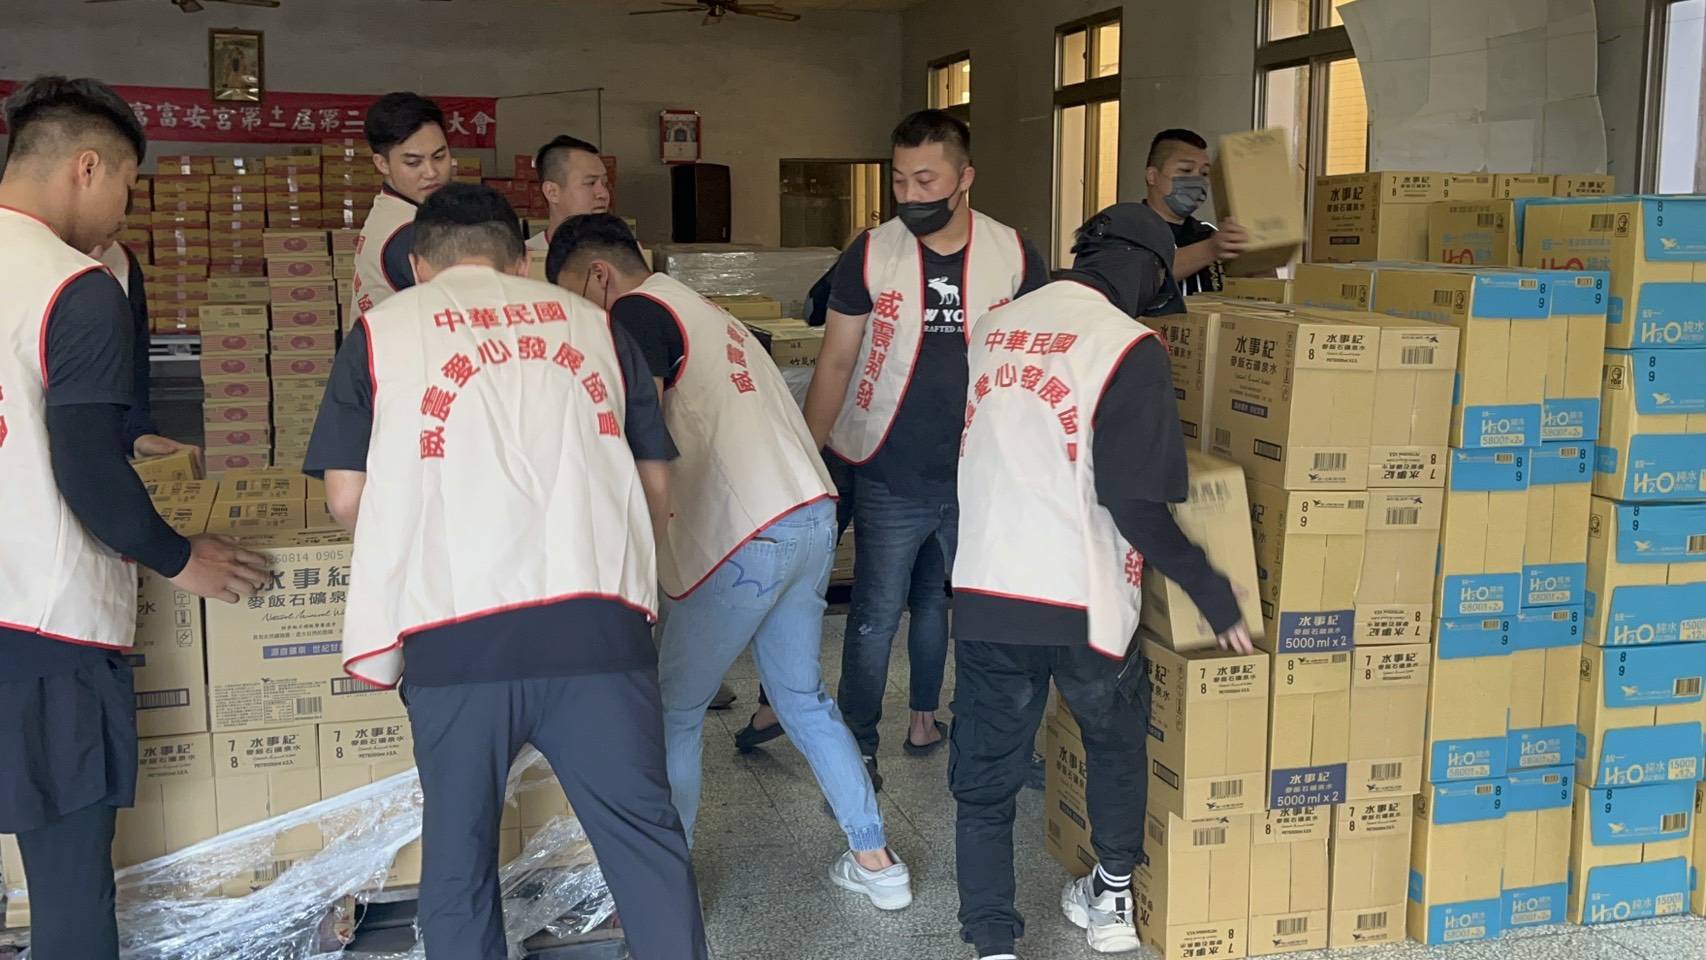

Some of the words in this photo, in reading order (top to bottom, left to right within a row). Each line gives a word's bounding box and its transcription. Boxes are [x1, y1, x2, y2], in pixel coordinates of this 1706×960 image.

[448, 111, 496, 135] 大會
[1657, 200, 1663, 212] 8
[1657, 215, 1663, 227] 9
[1540, 284, 1546, 294] 8
[1596, 279, 1602, 289] 8
[1538, 298, 1544, 308] 9
[1595, 293, 1601, 304] 9
[433, 301, 568, 332] 中華民國
[985, 329, 1078, 355] 中華民國
[1309, 333, 1315, 344] 7
[1235, 336, 1275, 359] 水事紀
[1308, 349, 1315, 360] 8
[1649, 356, 1656, 367] 8
[1648, 371, 1655, 381] 9
[1430, 454, 1436, 464] 8
[1580, 448, 1586, 459] 8
[1516, 457, 1522, 468] 8
[1579, 462, 1585, 473] 9
[1516, 471, 1522, 482] 9
[1302, 502, 1308, 512] 8
[1634, 504, 1640, 516] 8
[1300, 516, 1307, 527] 9
[1632, 520, 1639, 531] 9
[316, 550, 344, 560] 0905
[1298, 615, 1340, 626] 水事紀
[1415, 611, 1421, 622] 8
[1572, 612, 1577, 622] 8
[1502, 621, 1509, 632] 8
[1571, 625, 1577, 635] 9
[1286, 638, 1315, 649] 5000
[1317, 637, 1330, 647] ml
[1341, 636, 1347, 646] 2
[1501, 635, 1508, 645] 9
[1365, 656, 1371, 666] 7
[1620, 652, 1626, 662] 8
[1288, 659, 1294, 670] 8
[1200, 668, 1206, 679] 7
[1365, 669, 1371, 680] 8
[1618, 666, 1625, 676] 9
[1287, 674, 1294, 685] 9
[1200, 683, 1207, 694] 8
[333, 730, 341, 742] 7
[228, 740, 236, 752] 7
[336, 747, 343, 758] 8
[230, 757, 238, 768] 8
[1290, 772, 1330, 784] 水事紀
[1495, 786, 1501, 796] 8
[1607, 789, 1612, 800] 8
[1277, 795, 1306, 806] 5000
[1307, 795, 1320, 804] ml
[1332, 792, 1339, 801] 2
[1494, 799, 1501, 809] 9
[1349, 807, 1355, 817] 7
[1605, 803, 1611, 813] 9
[1265, 810, 1271, 820] 7
[1265, 824, 1271, 834] 8
[1349, 821, 1355, 831] 8
[1228, 929, 1234, 939] 8
